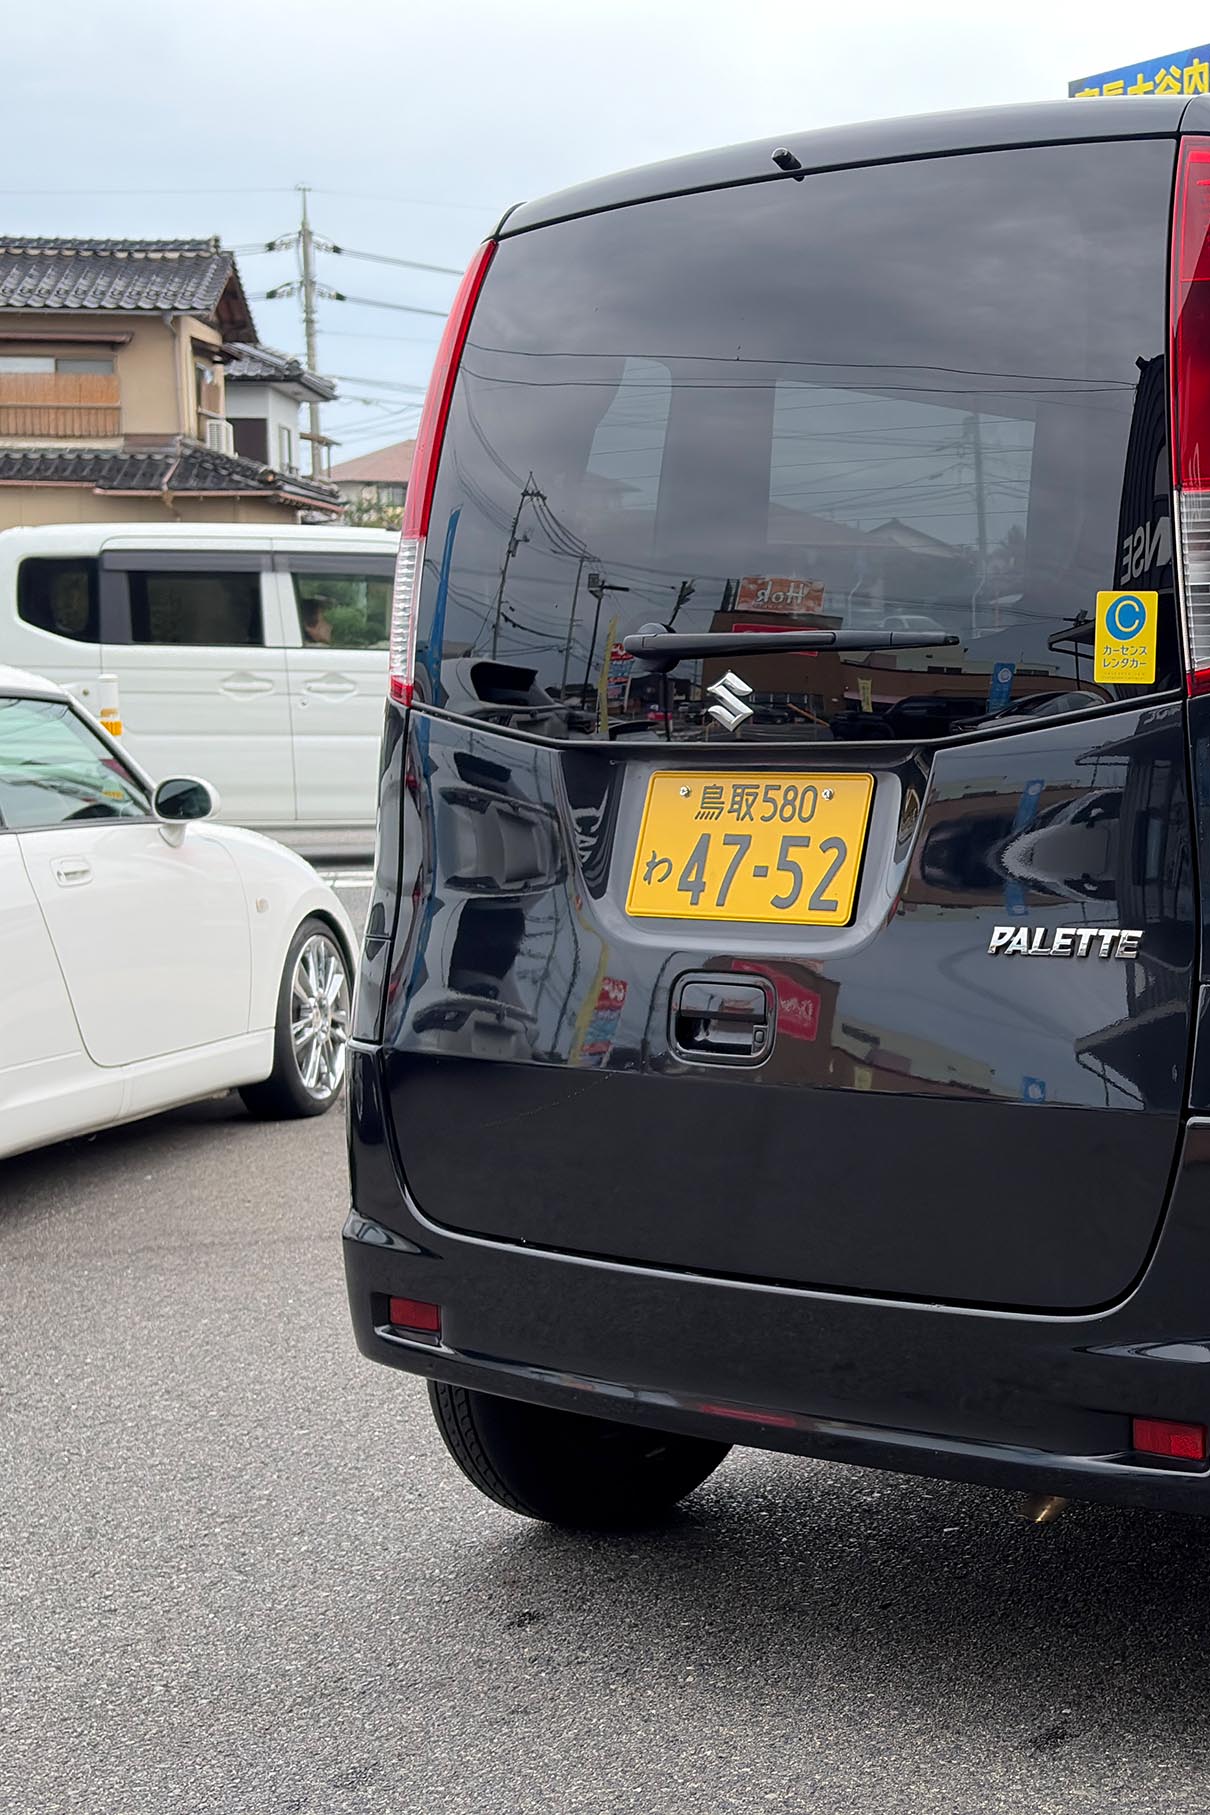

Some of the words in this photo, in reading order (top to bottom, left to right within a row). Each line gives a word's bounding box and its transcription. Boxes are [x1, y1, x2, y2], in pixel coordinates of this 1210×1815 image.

[1103, 645, 1147, 656] カーセンス
[1103, 658, 1147, 669] レンタカー
[643, 850, 673, 884] わ
[677, 833, 848, 911] 47-52
[987, 926, 1145, 960] PALETTE
